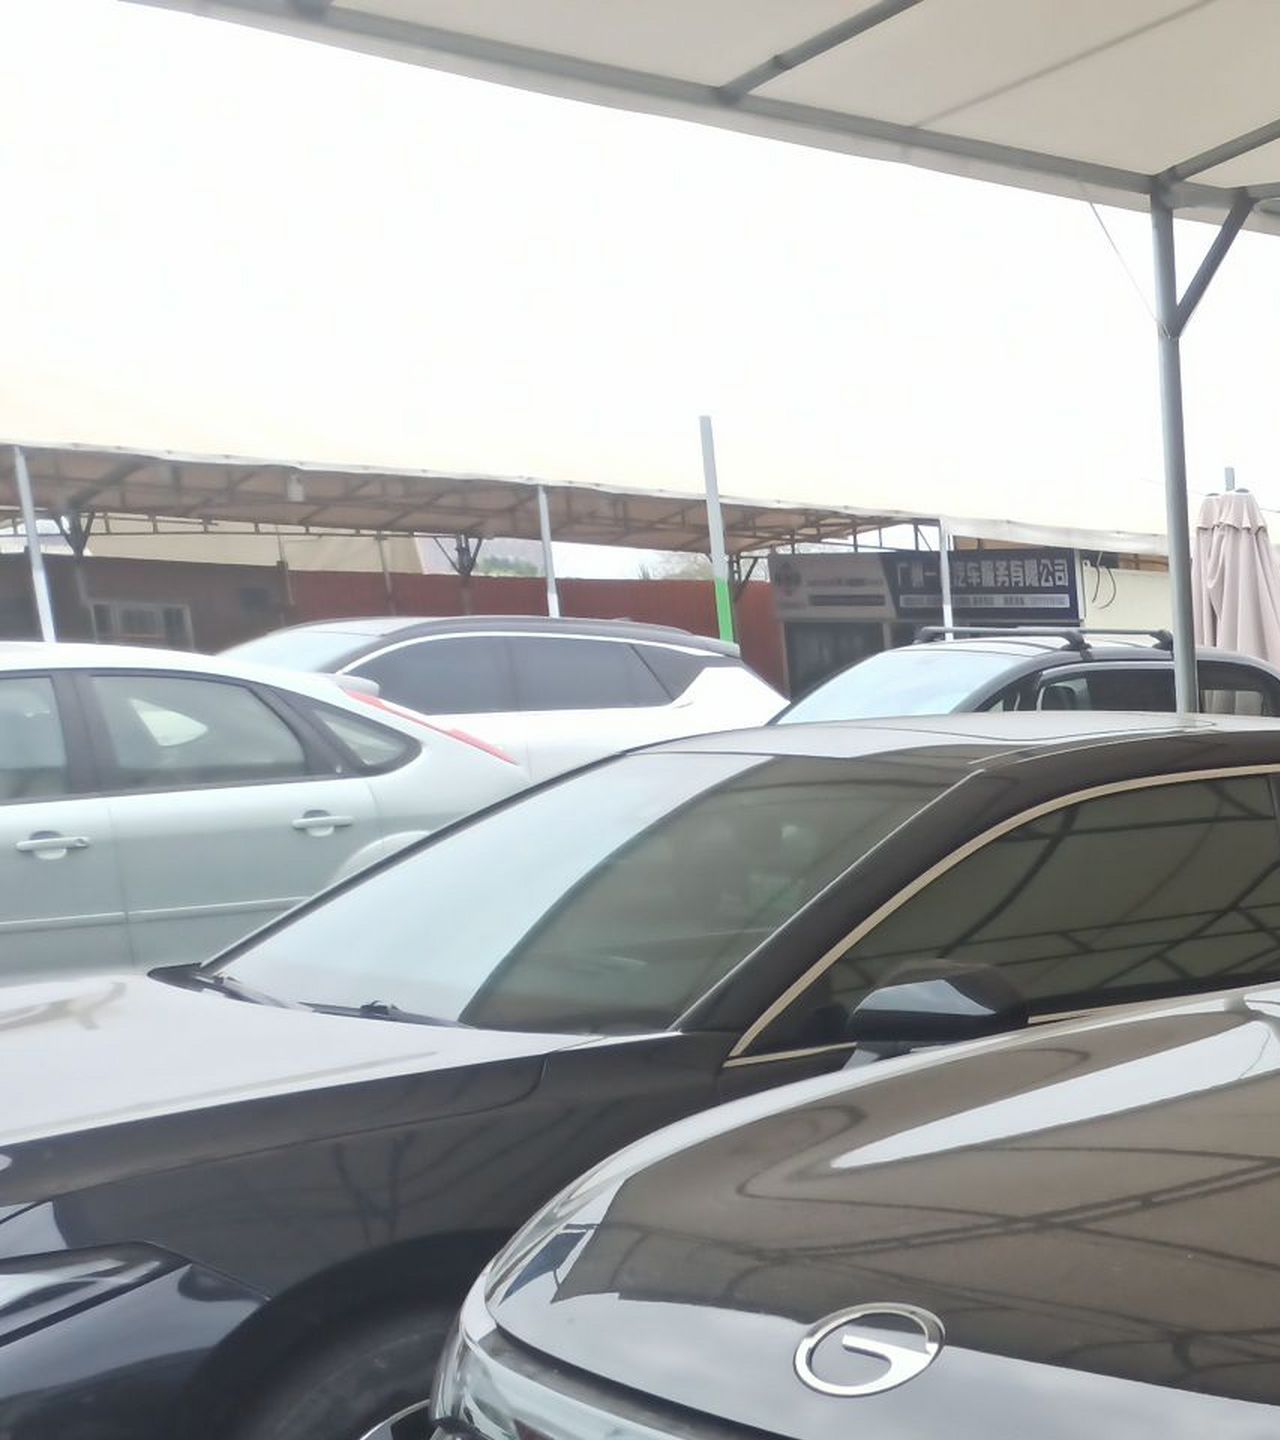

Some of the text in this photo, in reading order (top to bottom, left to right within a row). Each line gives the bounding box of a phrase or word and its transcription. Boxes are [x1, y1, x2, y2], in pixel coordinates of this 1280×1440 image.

[896, 558, 1068, 588] 广州一汽车服务有限公司
